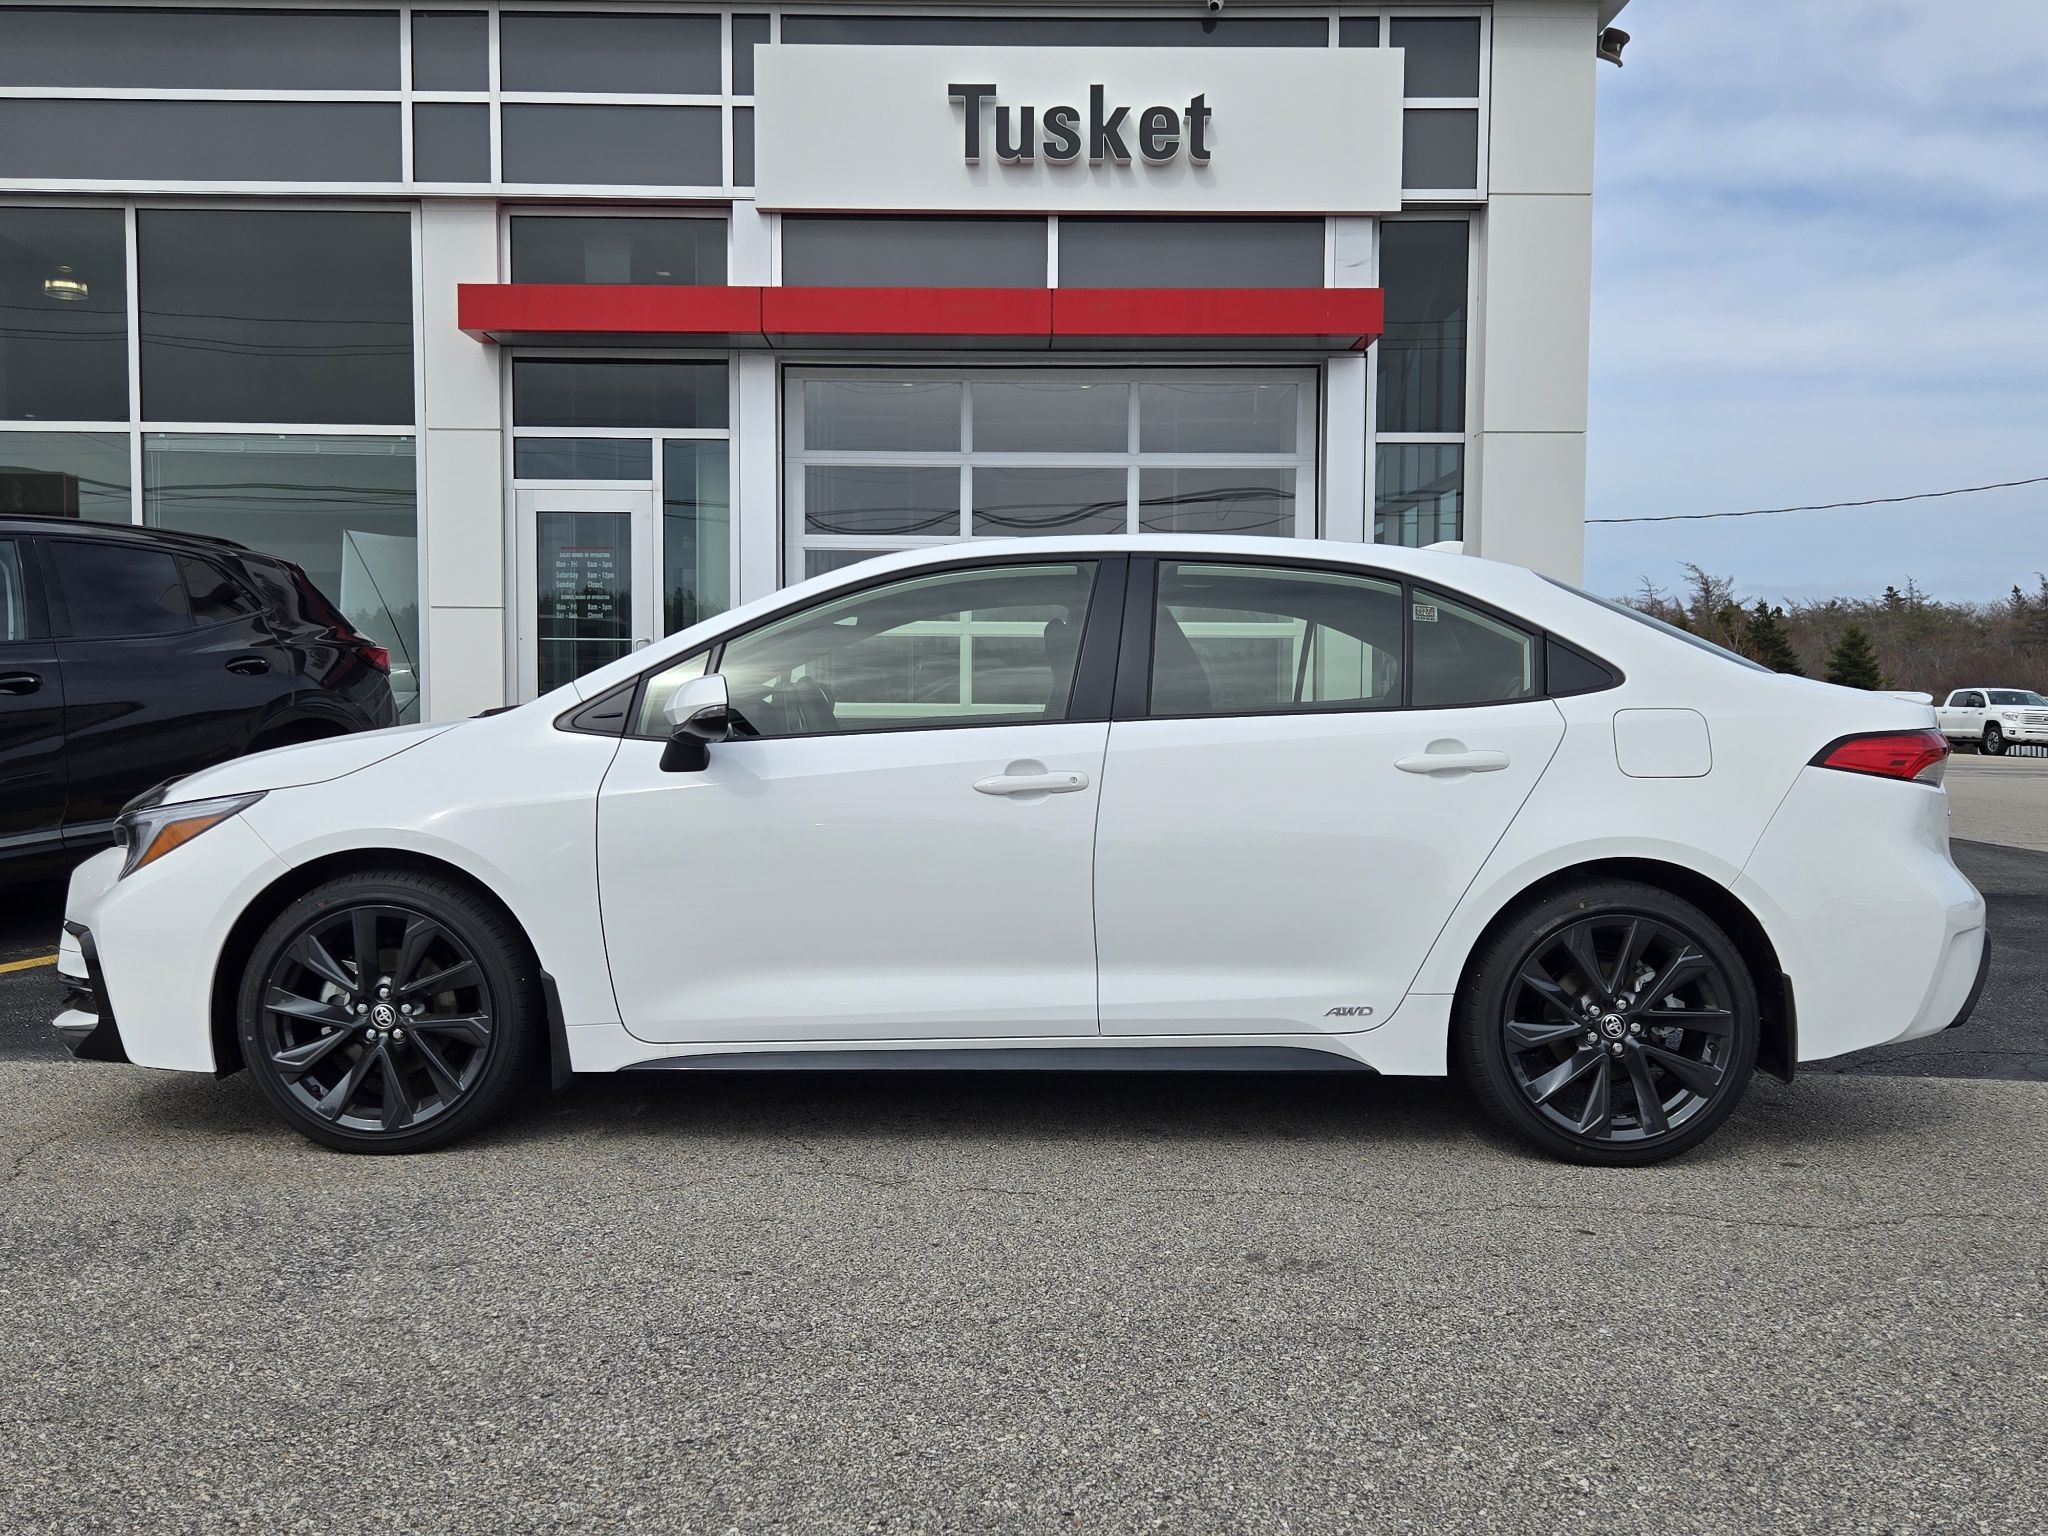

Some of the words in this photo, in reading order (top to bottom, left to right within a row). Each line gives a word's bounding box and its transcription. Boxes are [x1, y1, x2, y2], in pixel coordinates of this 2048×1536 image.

[948, 84, 1211, 164] Tusket
[556, 572, 578, 580] Saturday
[587, 571, 598, 579] 9am
[556, 581, 576, 589] Sunday
[602, 603, 612, 611] 5pm
[1323, 1006, 1374, 1017] AWD
